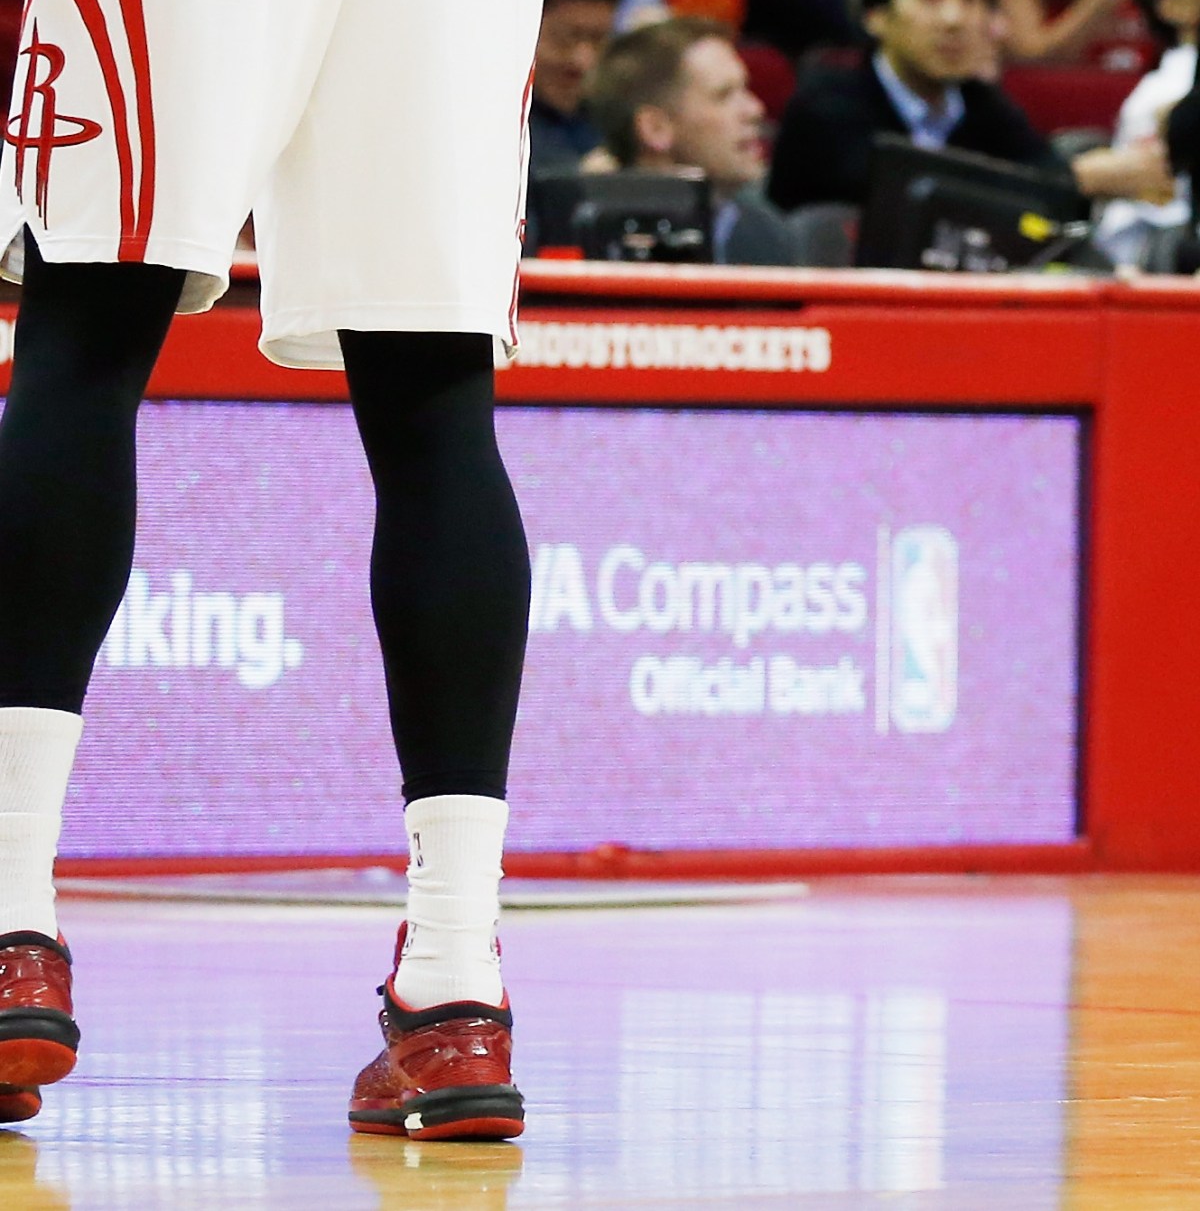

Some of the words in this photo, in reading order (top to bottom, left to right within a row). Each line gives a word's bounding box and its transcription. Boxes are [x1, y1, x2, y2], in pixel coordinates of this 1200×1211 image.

[600, 544, 868, 648] Compass
[630, 656, 765, 716] Official
[769, 654, 866, 716] Bank
